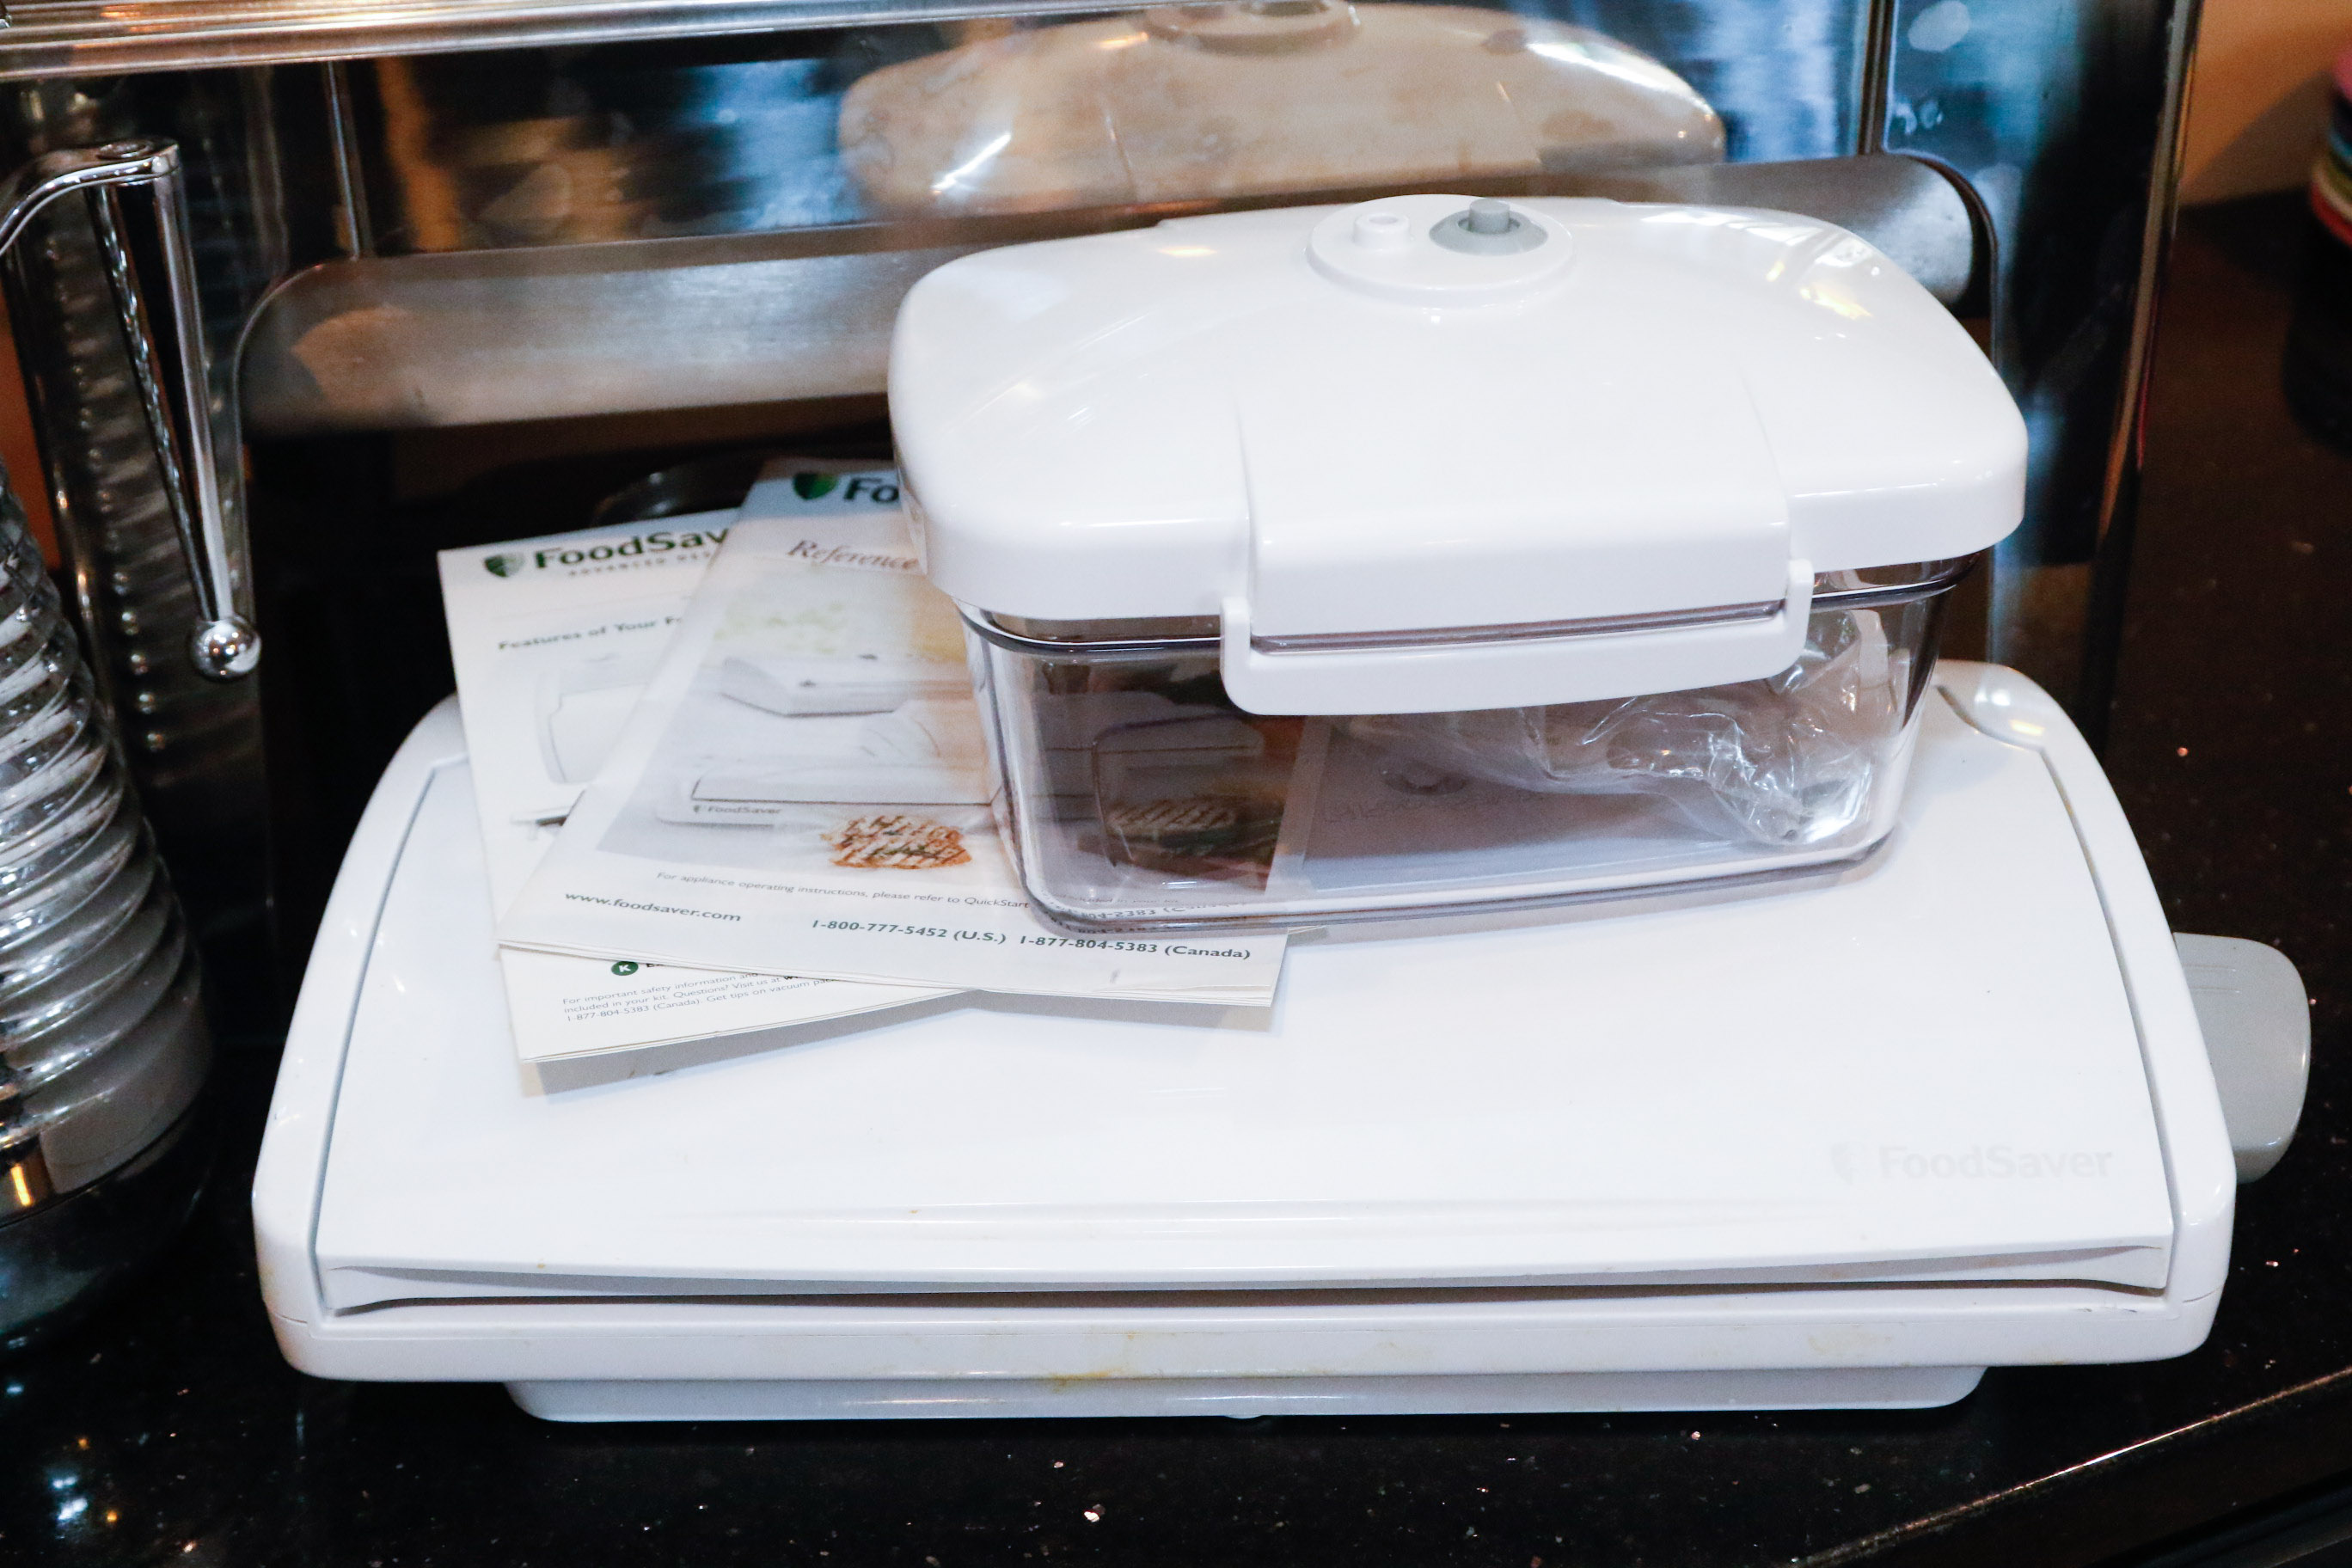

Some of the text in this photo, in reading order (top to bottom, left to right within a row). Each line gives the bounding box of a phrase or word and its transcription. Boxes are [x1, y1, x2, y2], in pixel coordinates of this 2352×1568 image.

[843, 476, 900, 503] Fo
[534, 527, 729, 569] FoodSav
[787, 538, 920, 570] Reference
[499, 631, 582, 650] Features
[587, 626, 607, 637] of
[614, 620, 657, 633] Your
[565, 891, 742, 922] www.foodsaver.com
[656, 871, 677, 881] For
[680, 874, 736, 887] appliance
[738, 882, 796, 894] operating
[798, 885, 869, 898] instructions,
[872, 891, 911, 901] please
[914, 893, 945, 903] refer
[964, 897, 1031, 910] QuickStart
[812, 919, 1252, 961] 1-800-777-5452 (U.S.) 1-877-804-5383 (Canada)
[618, 964, 632, 973] K
[564, 1001, 609, 1014] included
[625, 997, 649, 1008] your
[672, 985, 729, 999] Questions?
[732, 981, 755, 989] Visit
[567, 1005, 650, 1021] 1-877-804-5383
[653, 999, 703, 1011] (Canada).
[706, 995, 727, 1003] Get
[730, 991, 750, 1001] tips
[769, 982, 810, 993] vacuum
[585, 989, 638, 1002] important
[640, 984, 672, 995] safety
[675, 976, 737, 989] information
[1878, 1144, 2113, 1179] FoodSaver
